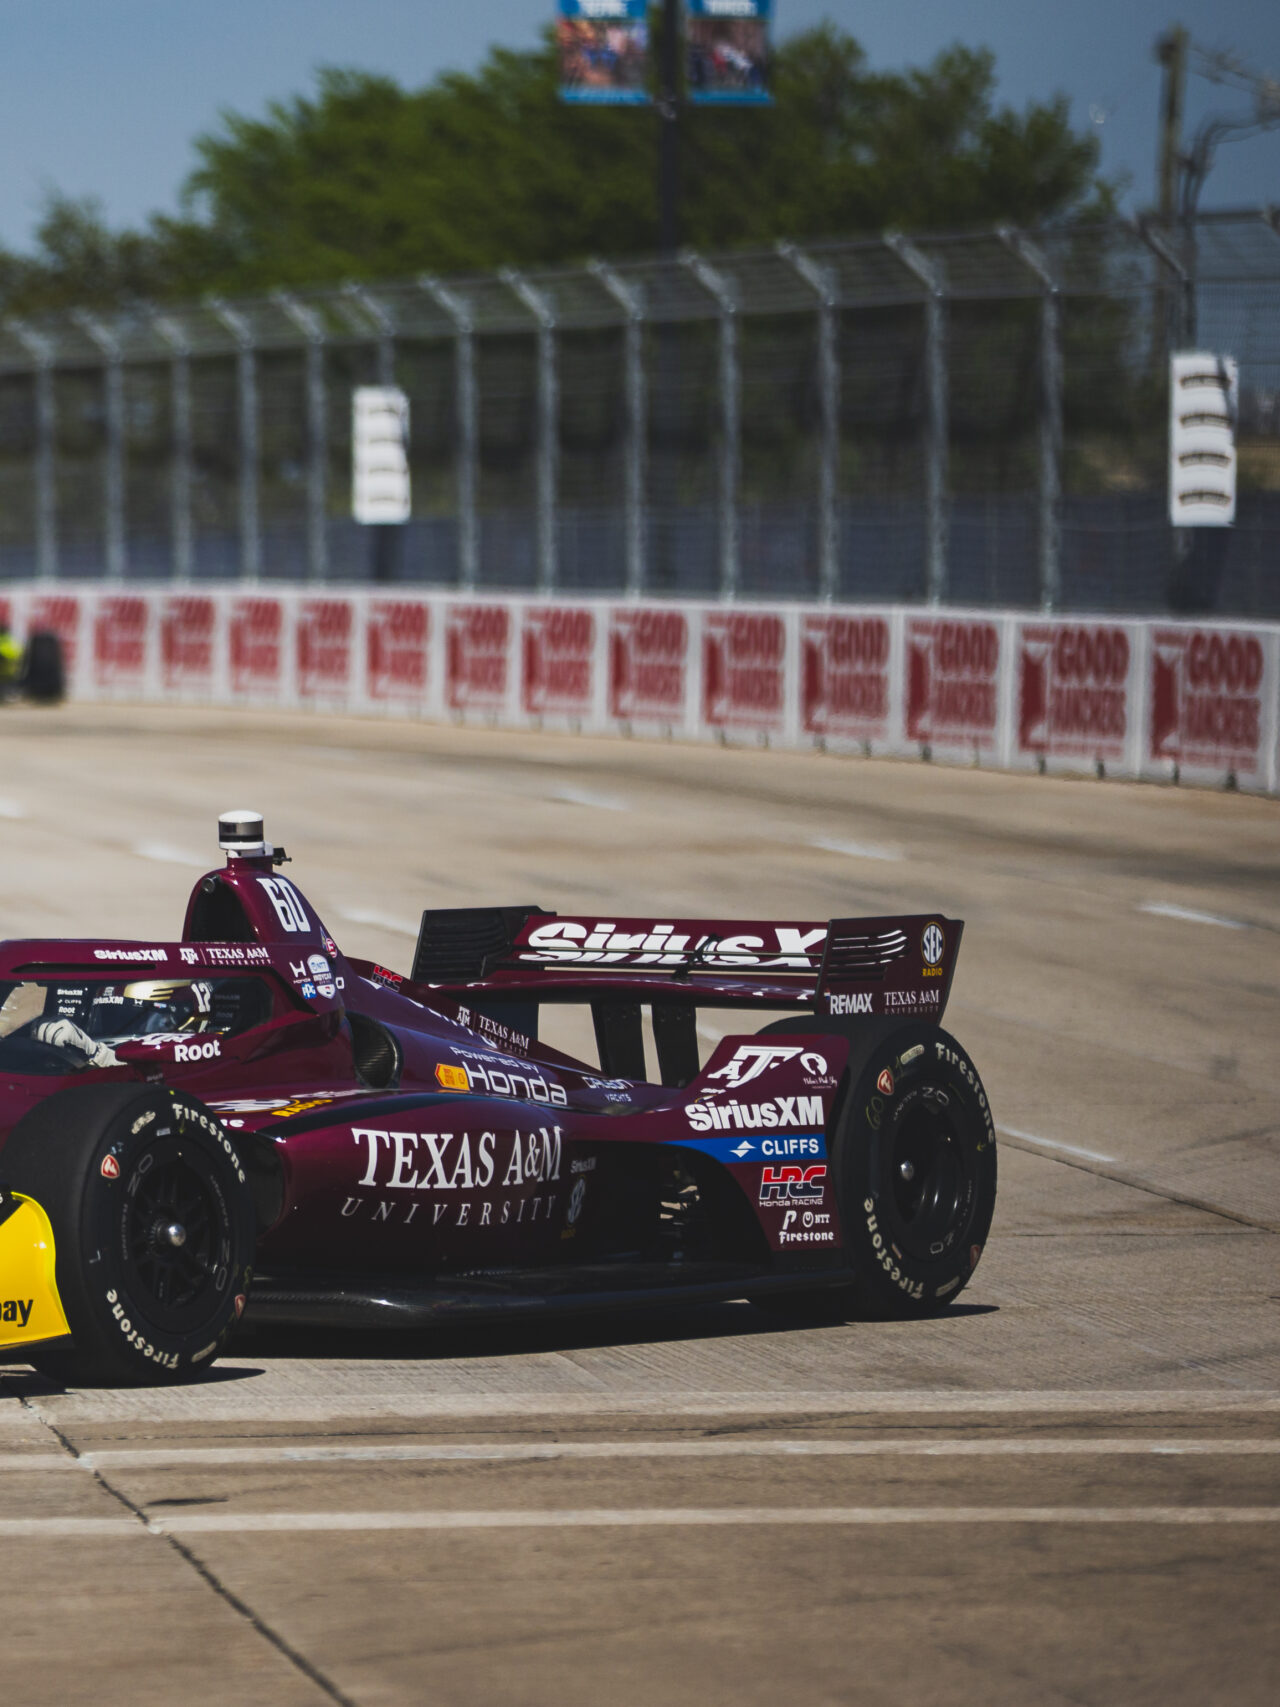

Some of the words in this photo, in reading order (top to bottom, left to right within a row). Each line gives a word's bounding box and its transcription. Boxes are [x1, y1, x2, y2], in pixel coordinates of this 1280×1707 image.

[1188, 632, 1263, 693] GOOD
[256, 878, 311, 932] 60
[94, 949, 169, 961] SiriusXM
[206, 948, 245, 959] TEXAS
[246, 947, 270, 958] A&M
[518, 922, 828, 967] SiriusX
[923, 925, 943, 963] SEC
[922, 968, 943, 976] RADIO
[884, 992, 916, 1006] TEXAS
[919, 990, 939, 1003] A&M
[884, 1006, 939, 1015] UNIVERSITY
[479, 1016, 508, 1039] TEXAS
[510, 1031, 529, 1050] A&M
[175, 1040, 221, 1062] Root
[450, 1046, 519, 1067] Powered
[462, 1061, 567, 1105] Honda
[935, 1042, 995, 1144] Firestone
[685, 1096, 825, 1131] SiriusXM
[172, 1103, 246, 1184] Firestone
[351, 1128, 495, 1189] TEXAS
[502, 1126, 562, 1185] A&M
[762, 1138, 819, 1155] CLIFFS
[759, 1165, 827, 1200] HRC
[341, 1194, 556, 1226] UNIVERSITY
[791, 1198, 823, 1206] RACING
[815, 1214, 830, 1224] NTT
[779, 1231, 834, 1244] Firestone
[864, 1197, 925, 1300] Firestone
[106, 1289, 179, 1369] Firestone
